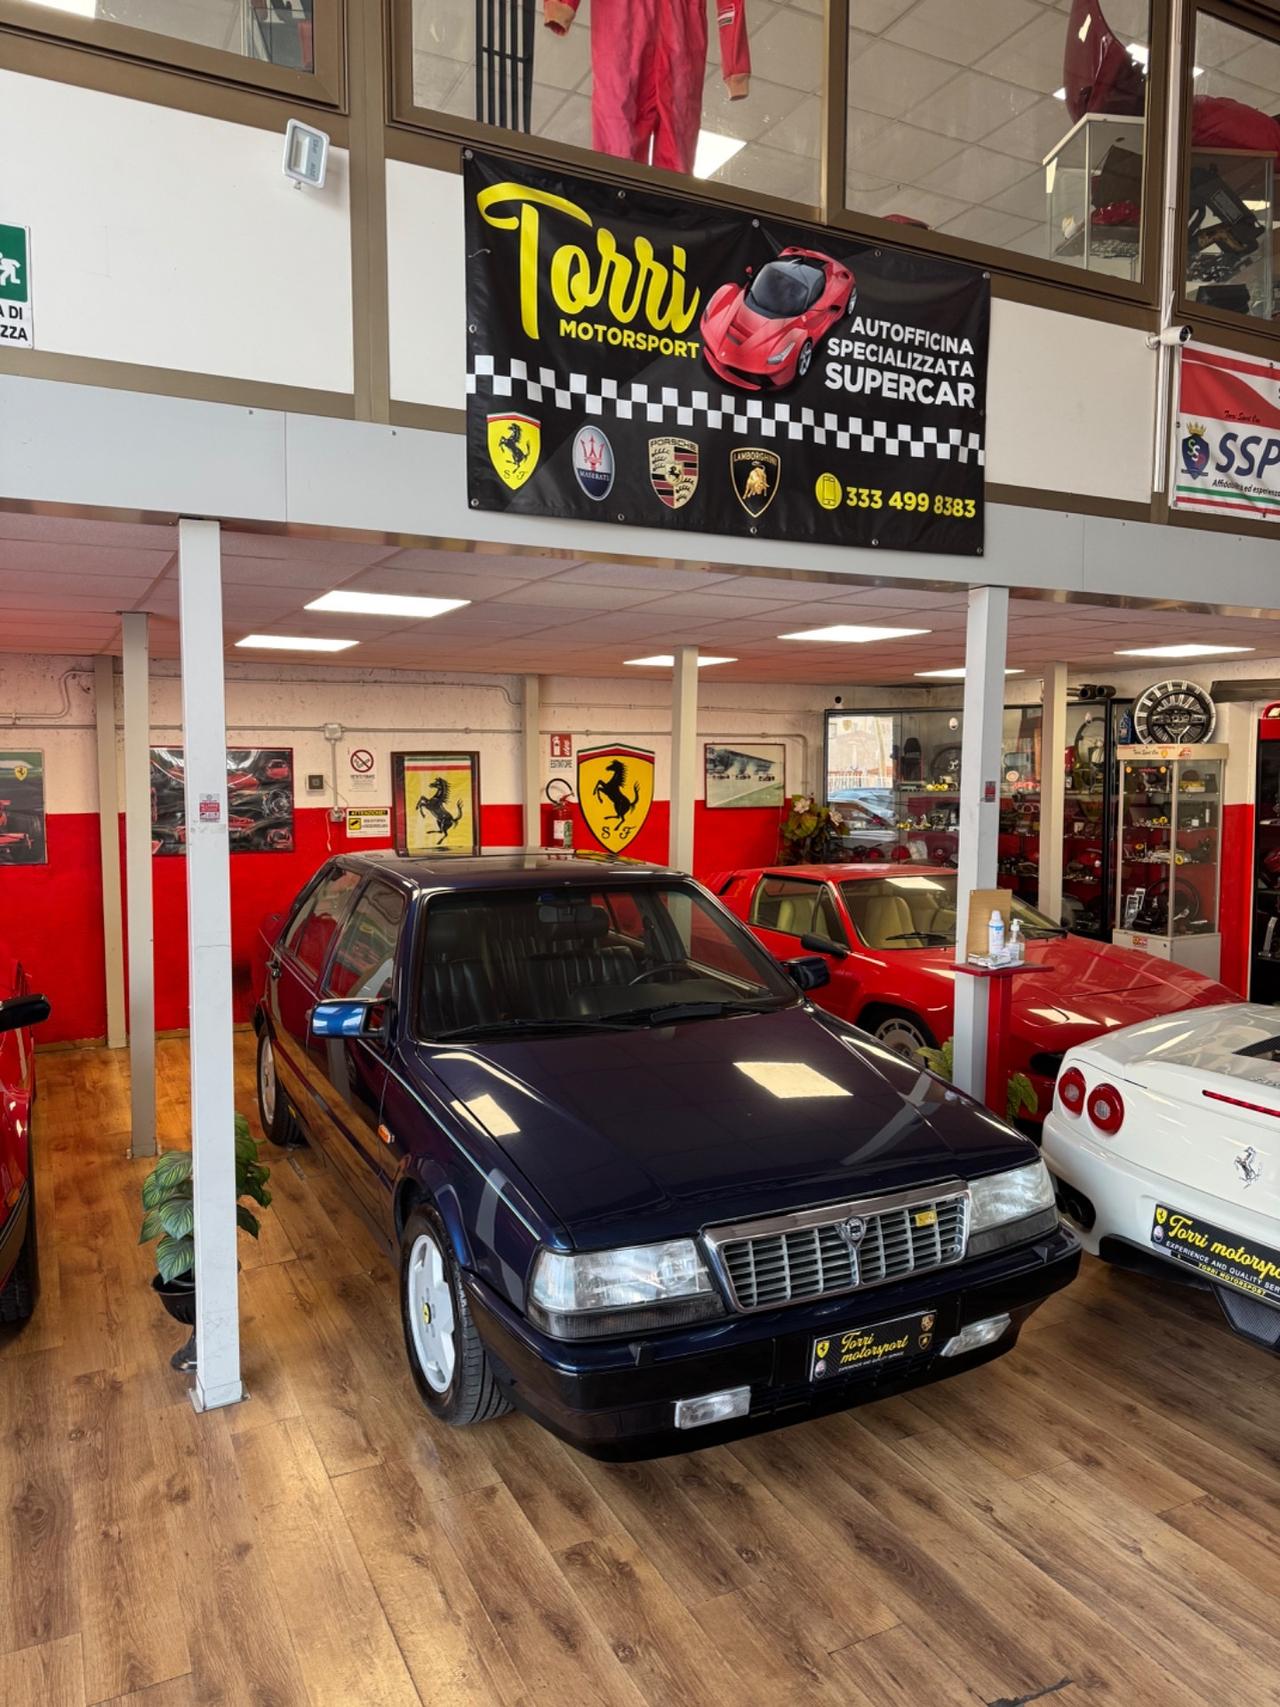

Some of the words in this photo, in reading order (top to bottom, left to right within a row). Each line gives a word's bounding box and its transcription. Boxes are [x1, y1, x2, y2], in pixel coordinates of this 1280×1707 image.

[476, 182, 701, 340] Torri
[9, 305, 23, 320] DI
[559, 319, 700, 359] MOTORSPORT
[850, 316, 975, 355] AUTOFFICINA
[827, 337, 975, 378] SPECIALIZZATA
[824, 362, 976, 409] SUPERCAR
[650, 438, 697, 452] PORSCHE
[846, 486, 883, 509] 333
[888, 491, 930, 512] 499
[934, 494, 976, 518] 8383
[1168, 1215, 1208, 1248] Torri
[1166, 1241, 1210, 1263] EXPERIENCE
[1211, 1260, 1227, 1271] AND
[1229, 1267, 1262, 1284] QUALITY
[840, 1334, 909, 1364] motorsport
[841, 1330, 875, 1353] Torri
